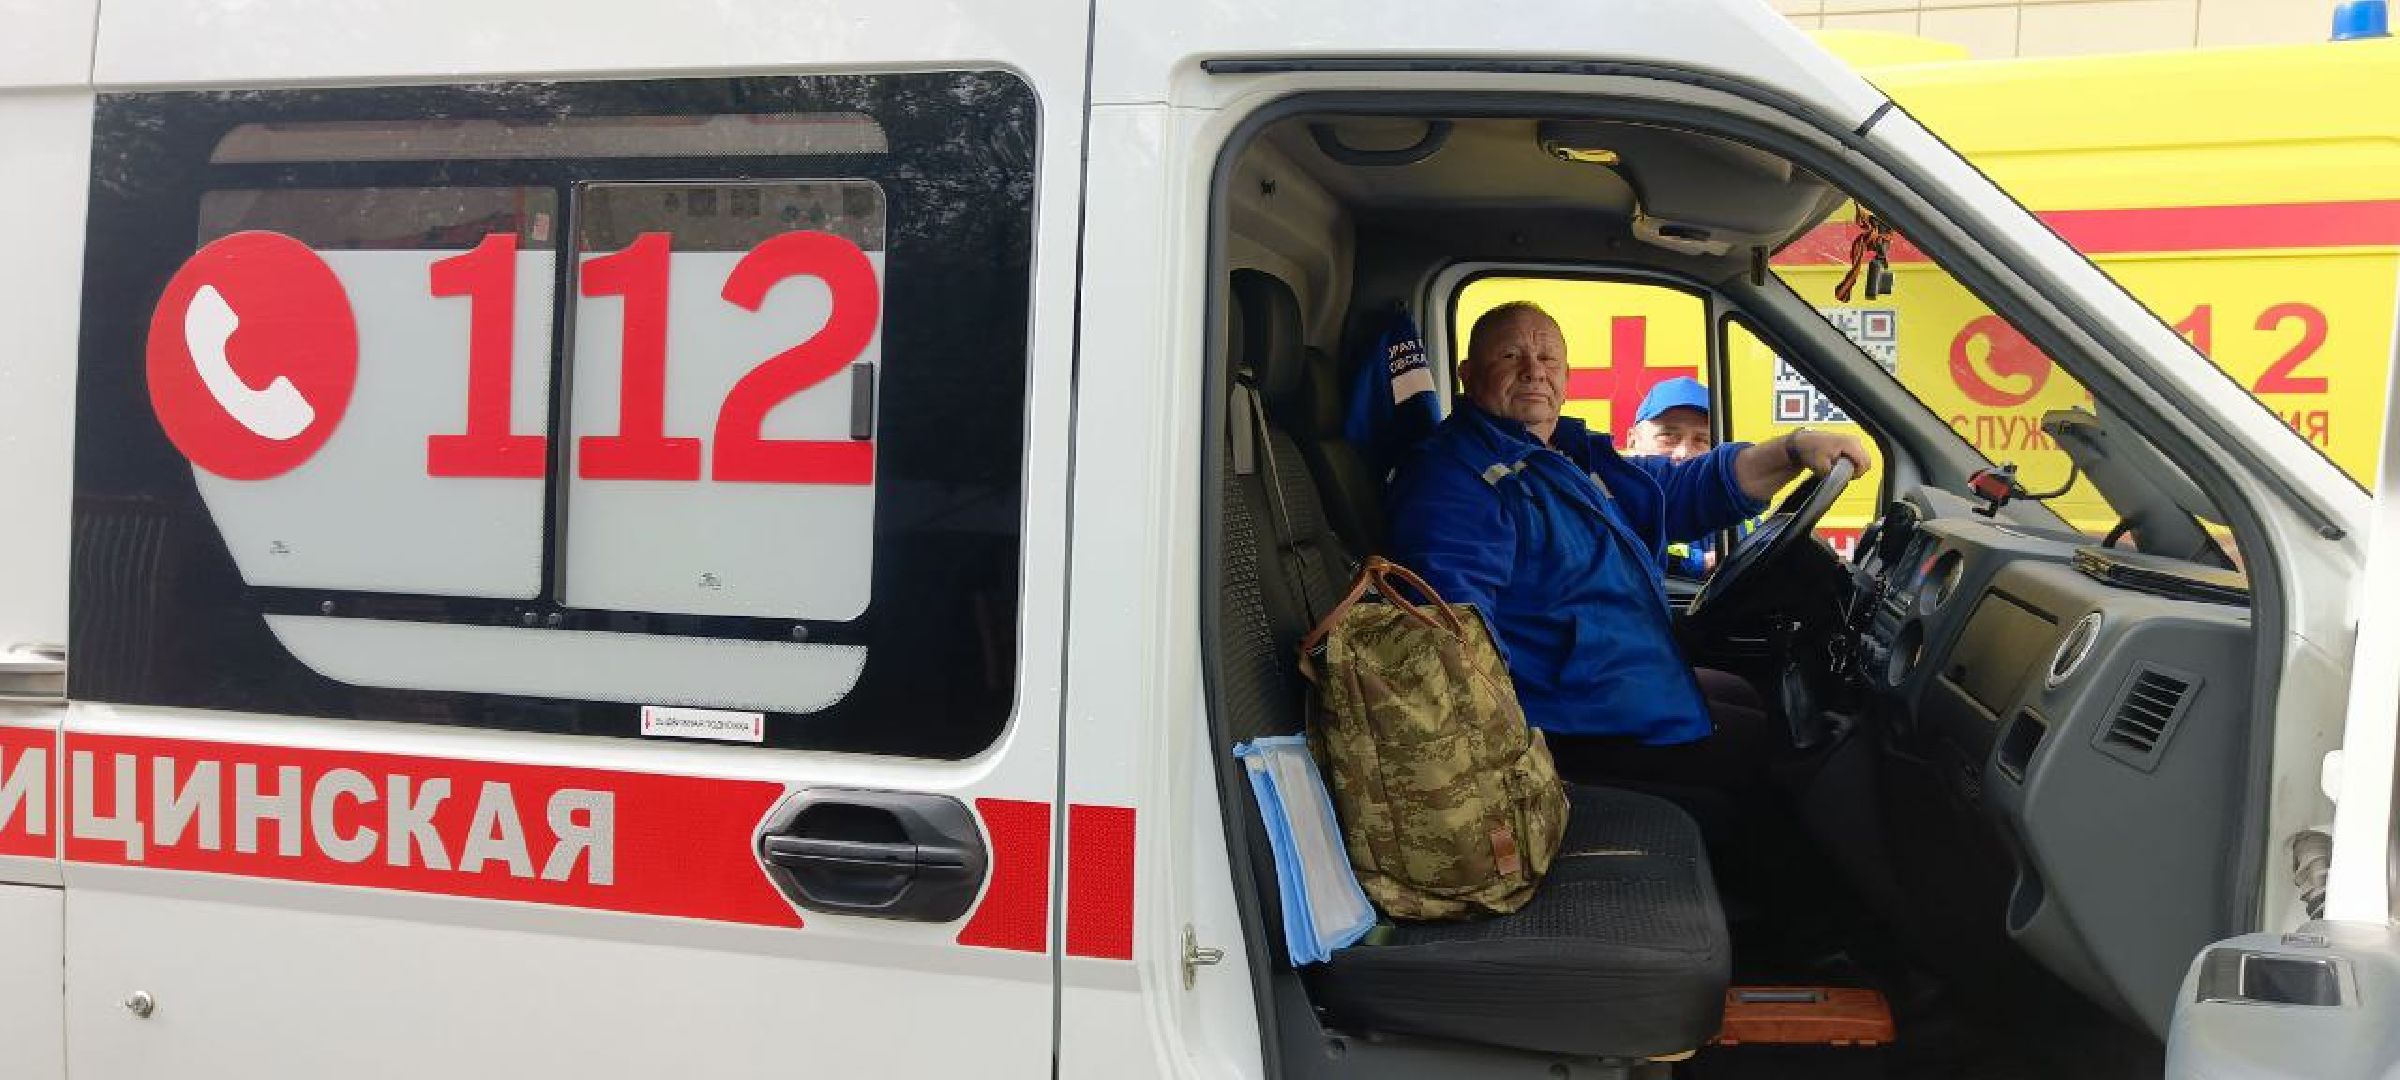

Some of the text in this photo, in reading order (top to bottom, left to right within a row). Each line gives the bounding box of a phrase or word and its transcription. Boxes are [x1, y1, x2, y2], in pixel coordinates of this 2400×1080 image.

[427, 229, 880, 485] 112
[2172, 302, 2329, 394] 12
[1950, 415, 2051, 450] СЛУЖ
